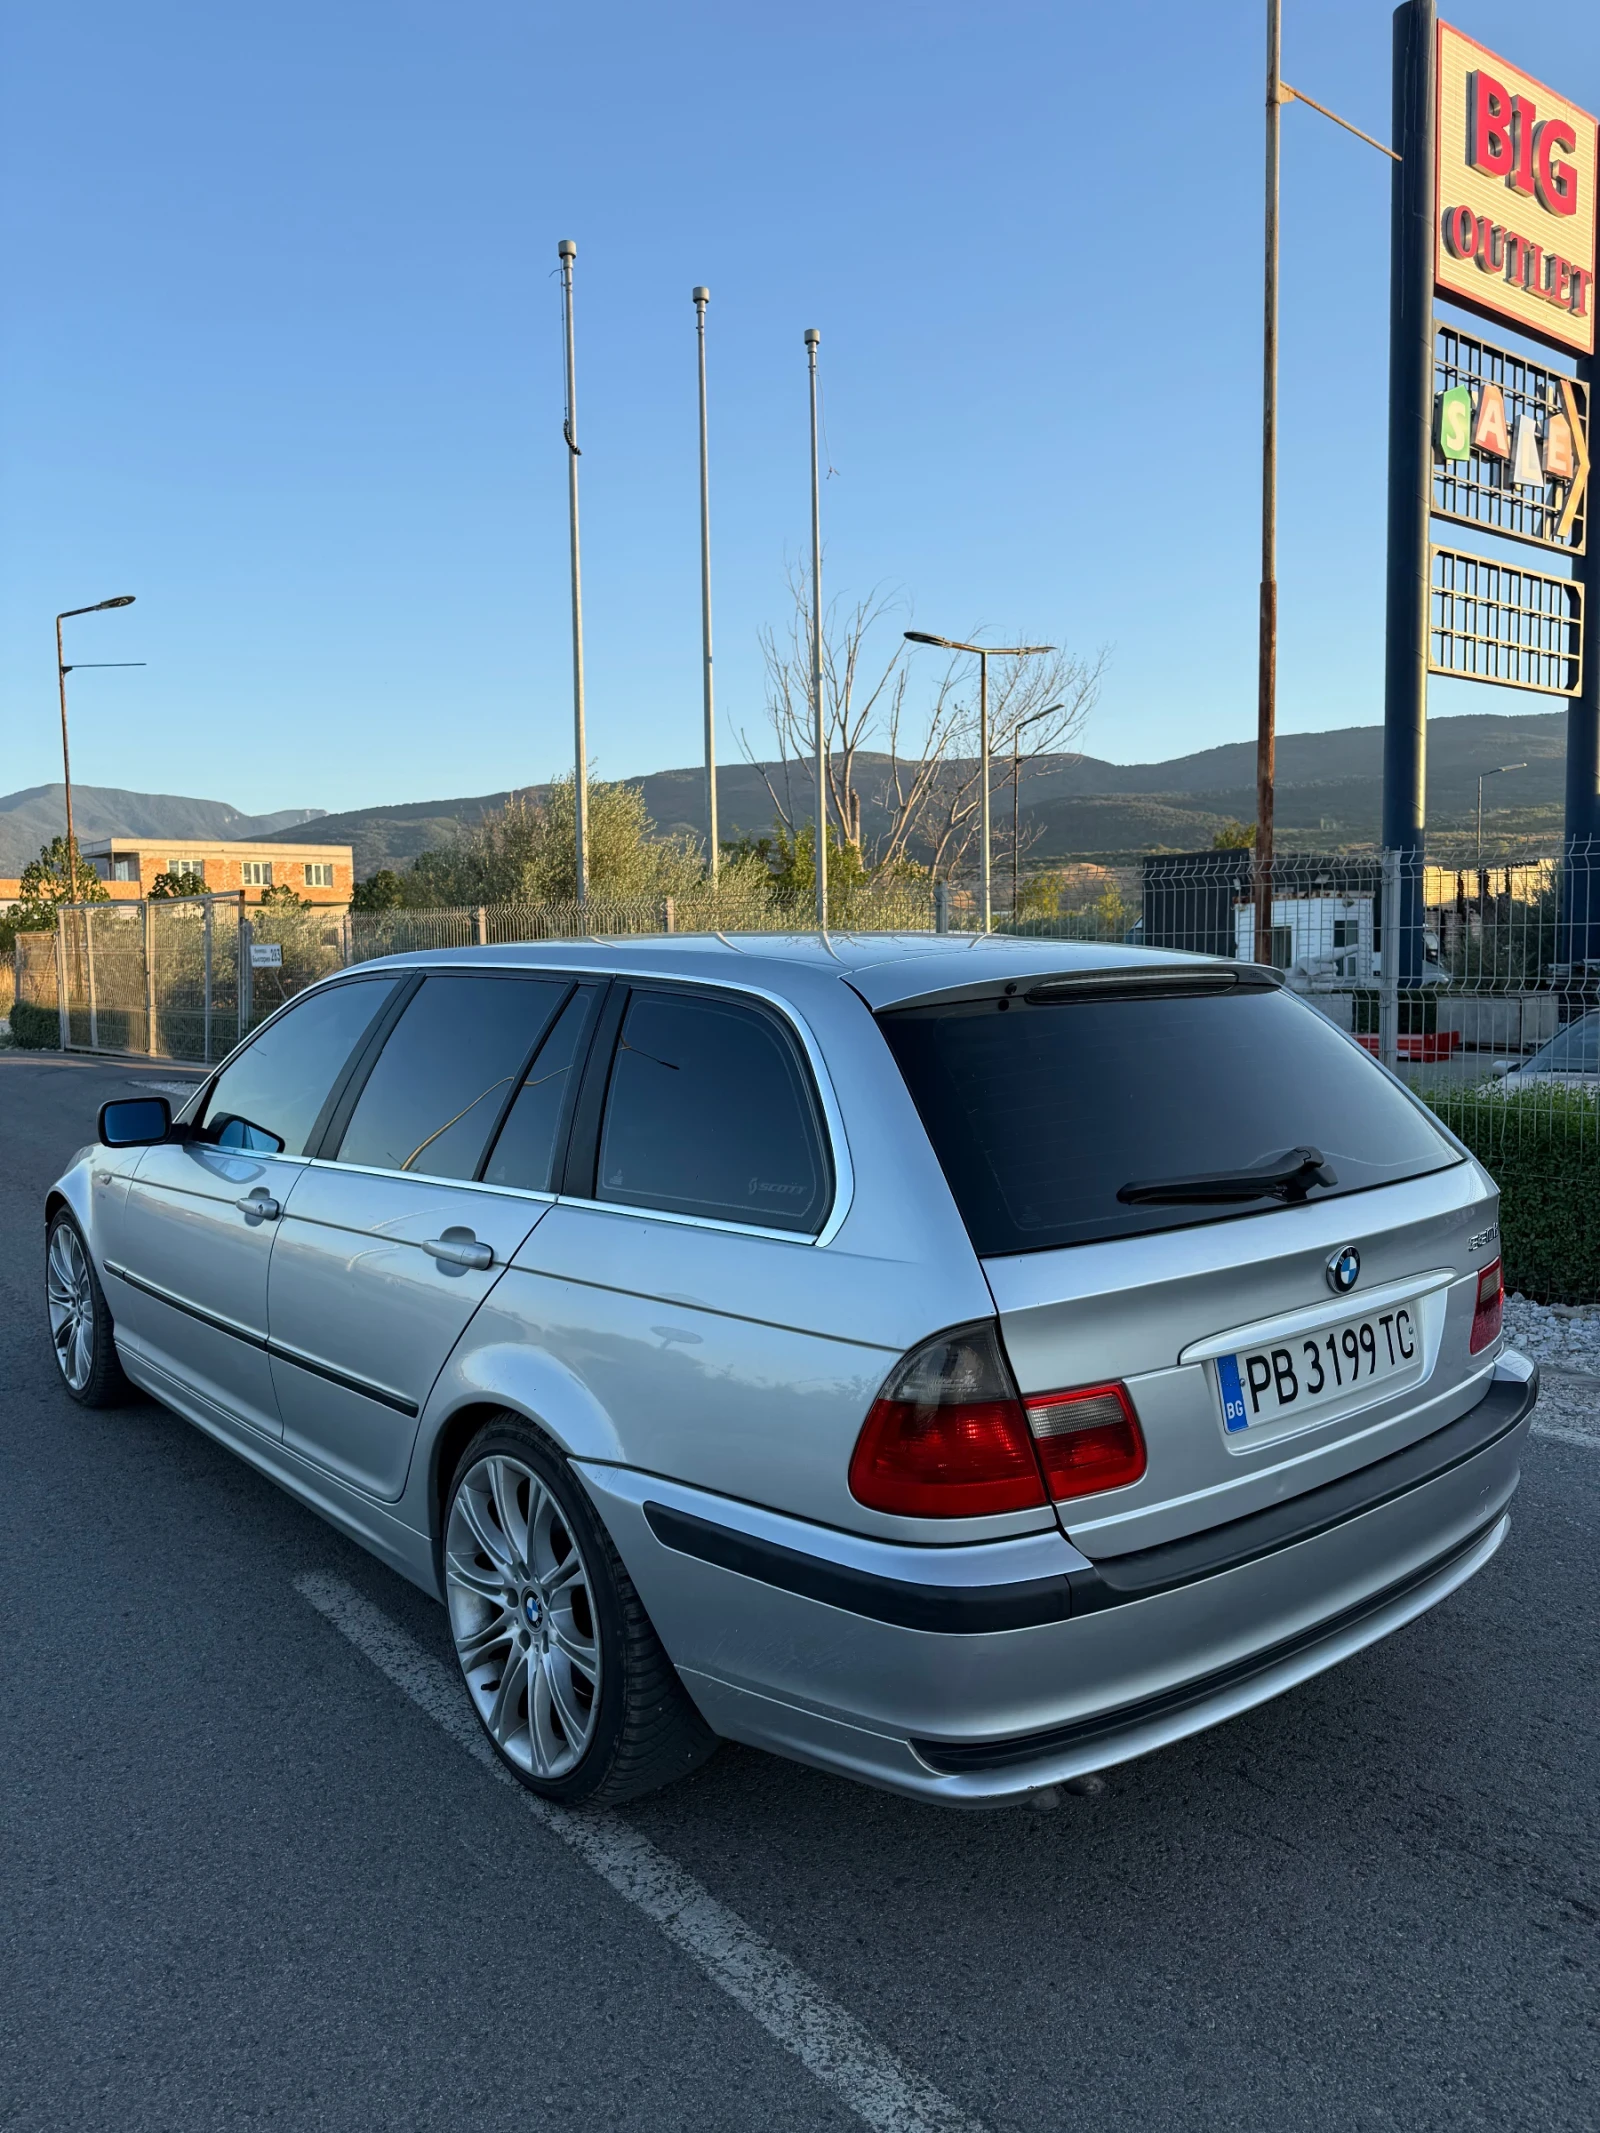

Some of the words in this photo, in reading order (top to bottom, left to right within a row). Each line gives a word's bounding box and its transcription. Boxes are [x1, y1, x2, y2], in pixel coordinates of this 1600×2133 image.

[1465, 69, 1577, 218] BIG
[1441, 205, 1593, 318] OUTLET
[1444, 399, 1569, 481] SALE
[757, 1182, 808, 1196] SCOTT
[1245, 1348, 1299, 1414] PB
[1303, 1323, 1376, 1395] 3199
[1378, 1309, 1414, 1367] TC
[1226, 1400, 1244, 1420] BG
